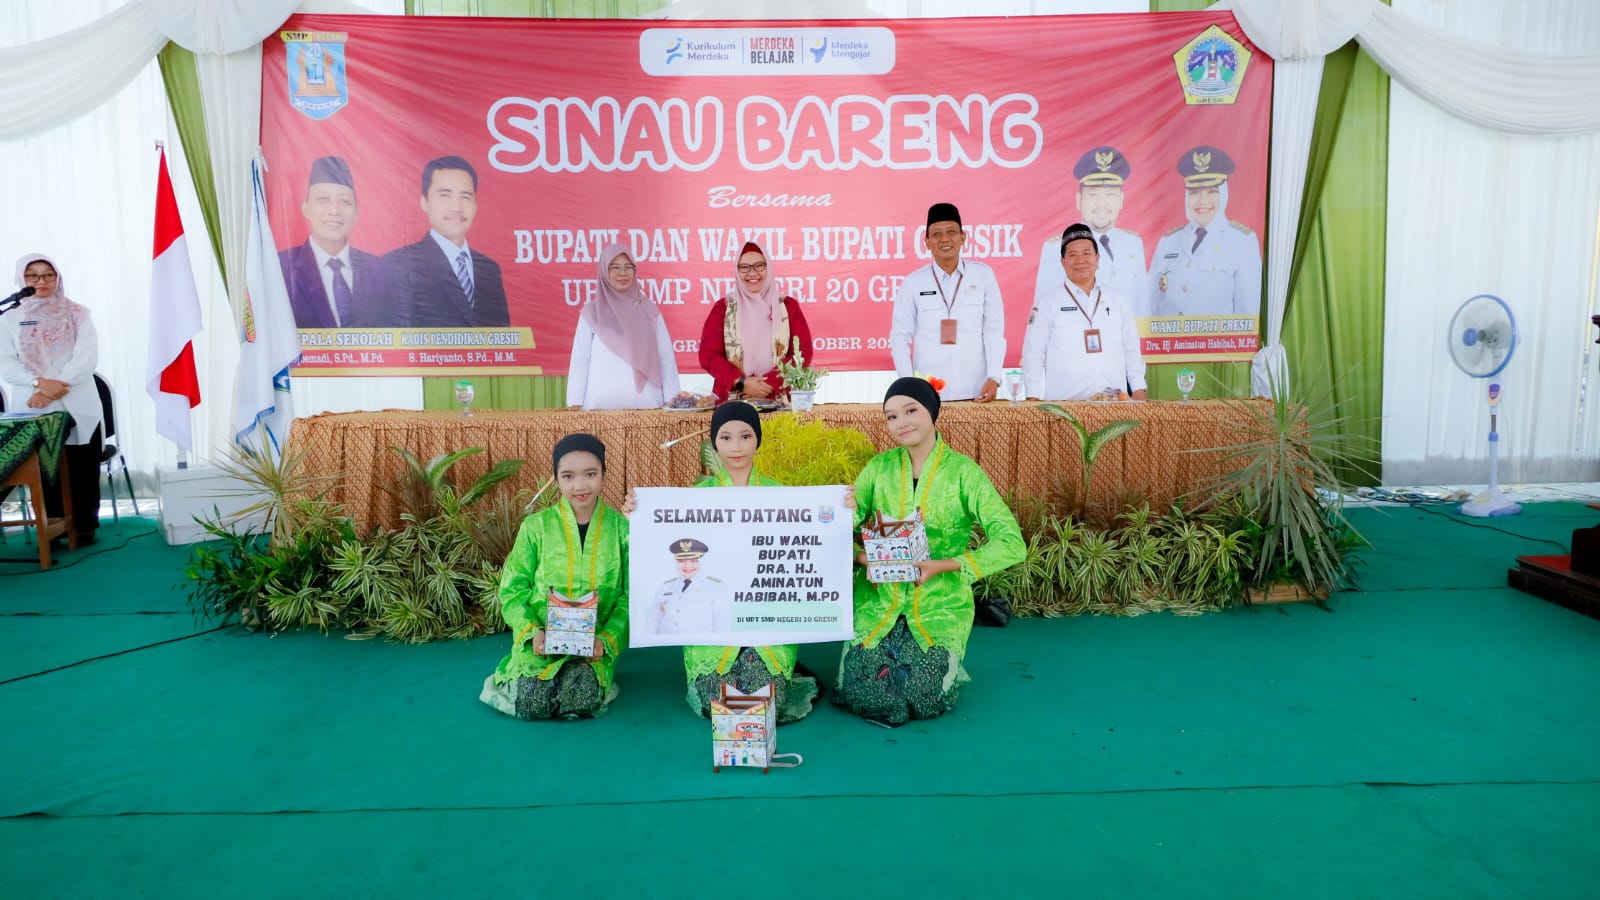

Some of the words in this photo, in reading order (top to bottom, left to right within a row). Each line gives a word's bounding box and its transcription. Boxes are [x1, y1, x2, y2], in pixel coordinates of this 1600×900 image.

[286, 31, 308, 41] SMP
[687, 41, 736, 51] Kurikulum
[750, 37, 794, 50] MERDEKA
[831, 41, 868, 50] Merdeka
[687, 52, 729, 61] Merdeka
[750, 50, 795, 64] BELAJAR
[831, 50, 871, 60] Mengajar
[486, 96, 724, 173] SINAU
[736, 94, 1043, 170] BARENG
[707, 185, 834, 209] Bersama
[627, 227, 690, 263] DAN
[801, 225, 906, 261] BUPATI
[913, 223, 1024, 260] GESIK
[561, 278, 598, 307] UP
[826, 277, 860, 303] 20
[1151, 320, 1181, 334] WAKIL
[1184, 319, 1219, 333] BUPATI
[1221, 318, 1256, 332] GRESIK
[297, 332, 334, 346] PALA
[335, 332, 393, 346] SEKOLAH
[401, 332, 428, 345] KADIS
[430, 332, 486, 345] PENDIDIKAN
[487, 332, 521, 345] GRESIK
[1174, 338, 1206, 350] Aminatun
[1208, 337, 1237, 349] Habibah,
[334, 352, 359, 364] S.Pd.,
[361, 352, 385, 364] M.Pd.
[408, 352, 418, 363] S.
[419, 352, 466, 366] Hariyanto,
[467, 352, 493, 364] S.Pd.,
[494, 351, 517, 363] M.M.
[653, 508, 736, 524] SELAMAT
[740, 507, 813, 524] DATANG
[752, 535, 775, 547] IBU
[780, 535, 823, 546] WAKIL
[758, 549, 811, 561] BUPATI
[756, 563, 790, 575] DRA.
[795, 563, 817, 574] HJ.
[750, 577, 824, 588] AMINATUN
[734, 591, 802, 603] HABIBAH,
[806, 591, 840, 602] M.PD
